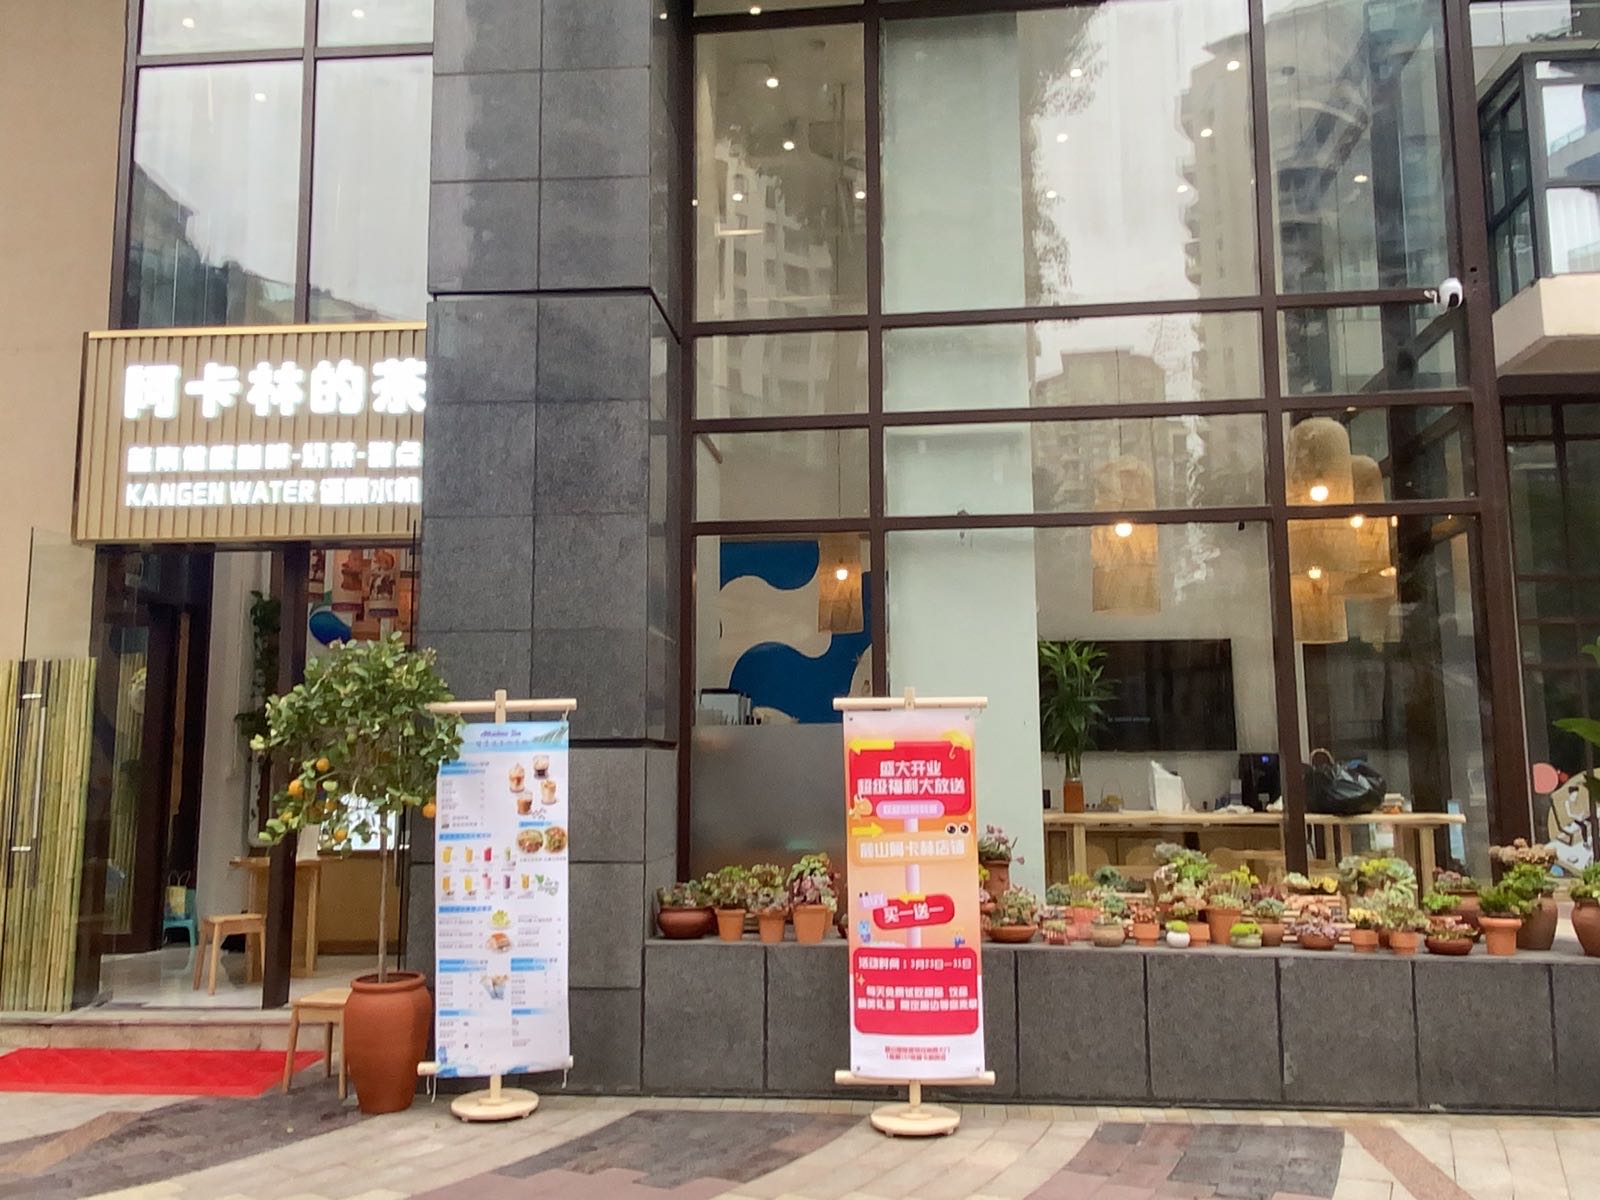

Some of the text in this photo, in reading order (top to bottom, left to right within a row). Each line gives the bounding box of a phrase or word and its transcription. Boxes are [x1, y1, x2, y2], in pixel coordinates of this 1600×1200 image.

[124, 358, 427, 418] 阿卡林的茶
[126, 480, 226, 506] KANGEN
[229, 478, 316, 504] WATER
[879, 760, 942, 777] 盛大开业
[857, 777, 966, 795] 超级福利大放送
[883, 902, 944, 923] 买一送一
